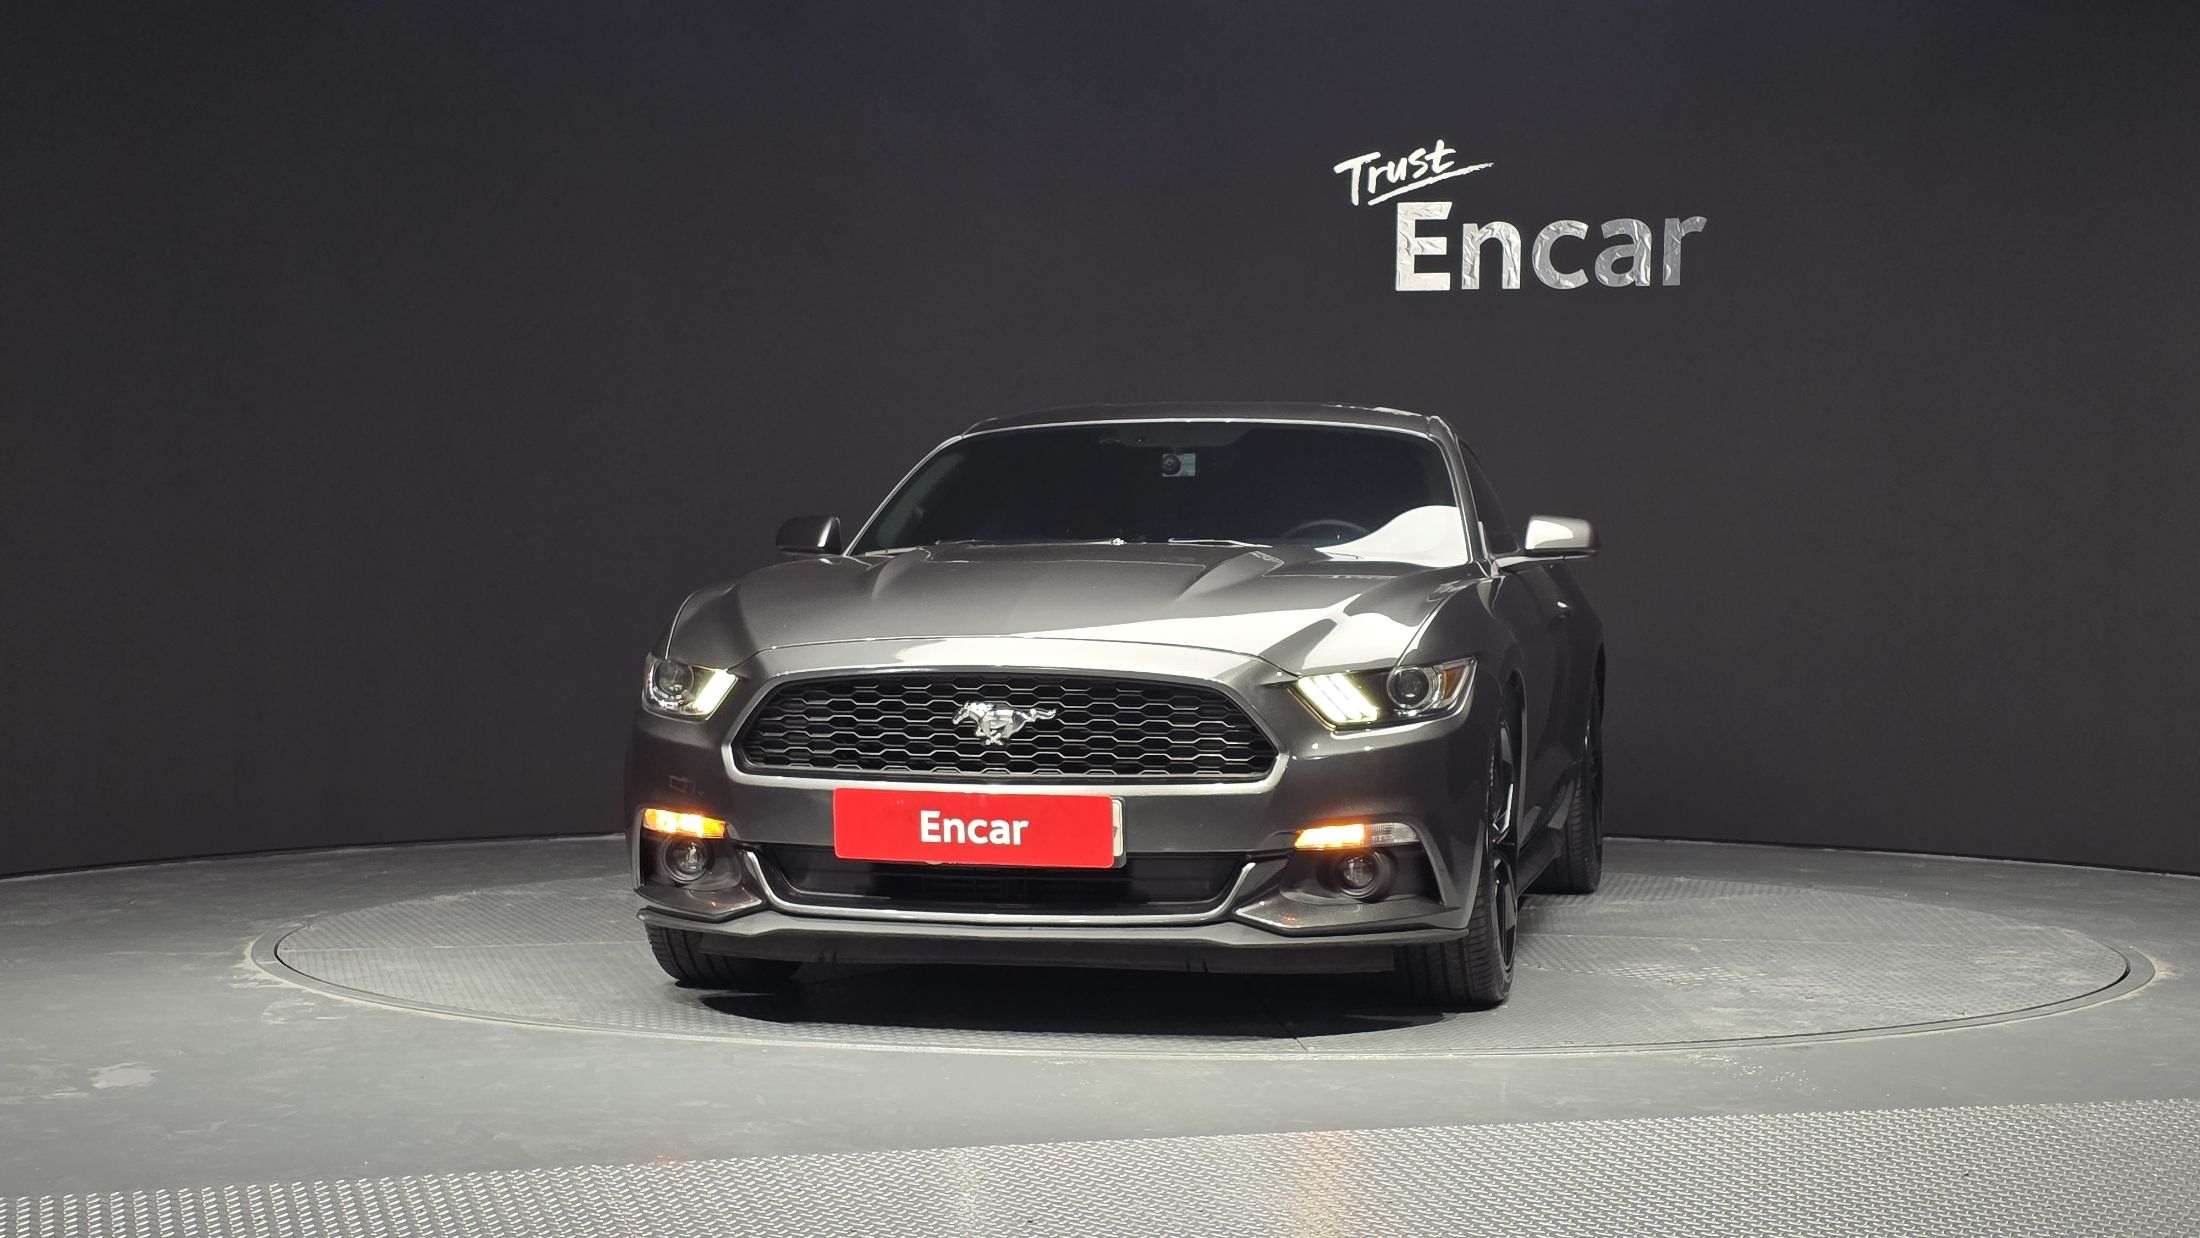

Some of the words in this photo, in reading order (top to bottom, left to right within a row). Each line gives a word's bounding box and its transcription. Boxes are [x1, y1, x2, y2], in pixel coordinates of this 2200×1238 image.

[1333, 139, 1457, 206] Trust
[1395, 201, 1708, 291] Encar
[919, 809, 1029, 845] Encar
